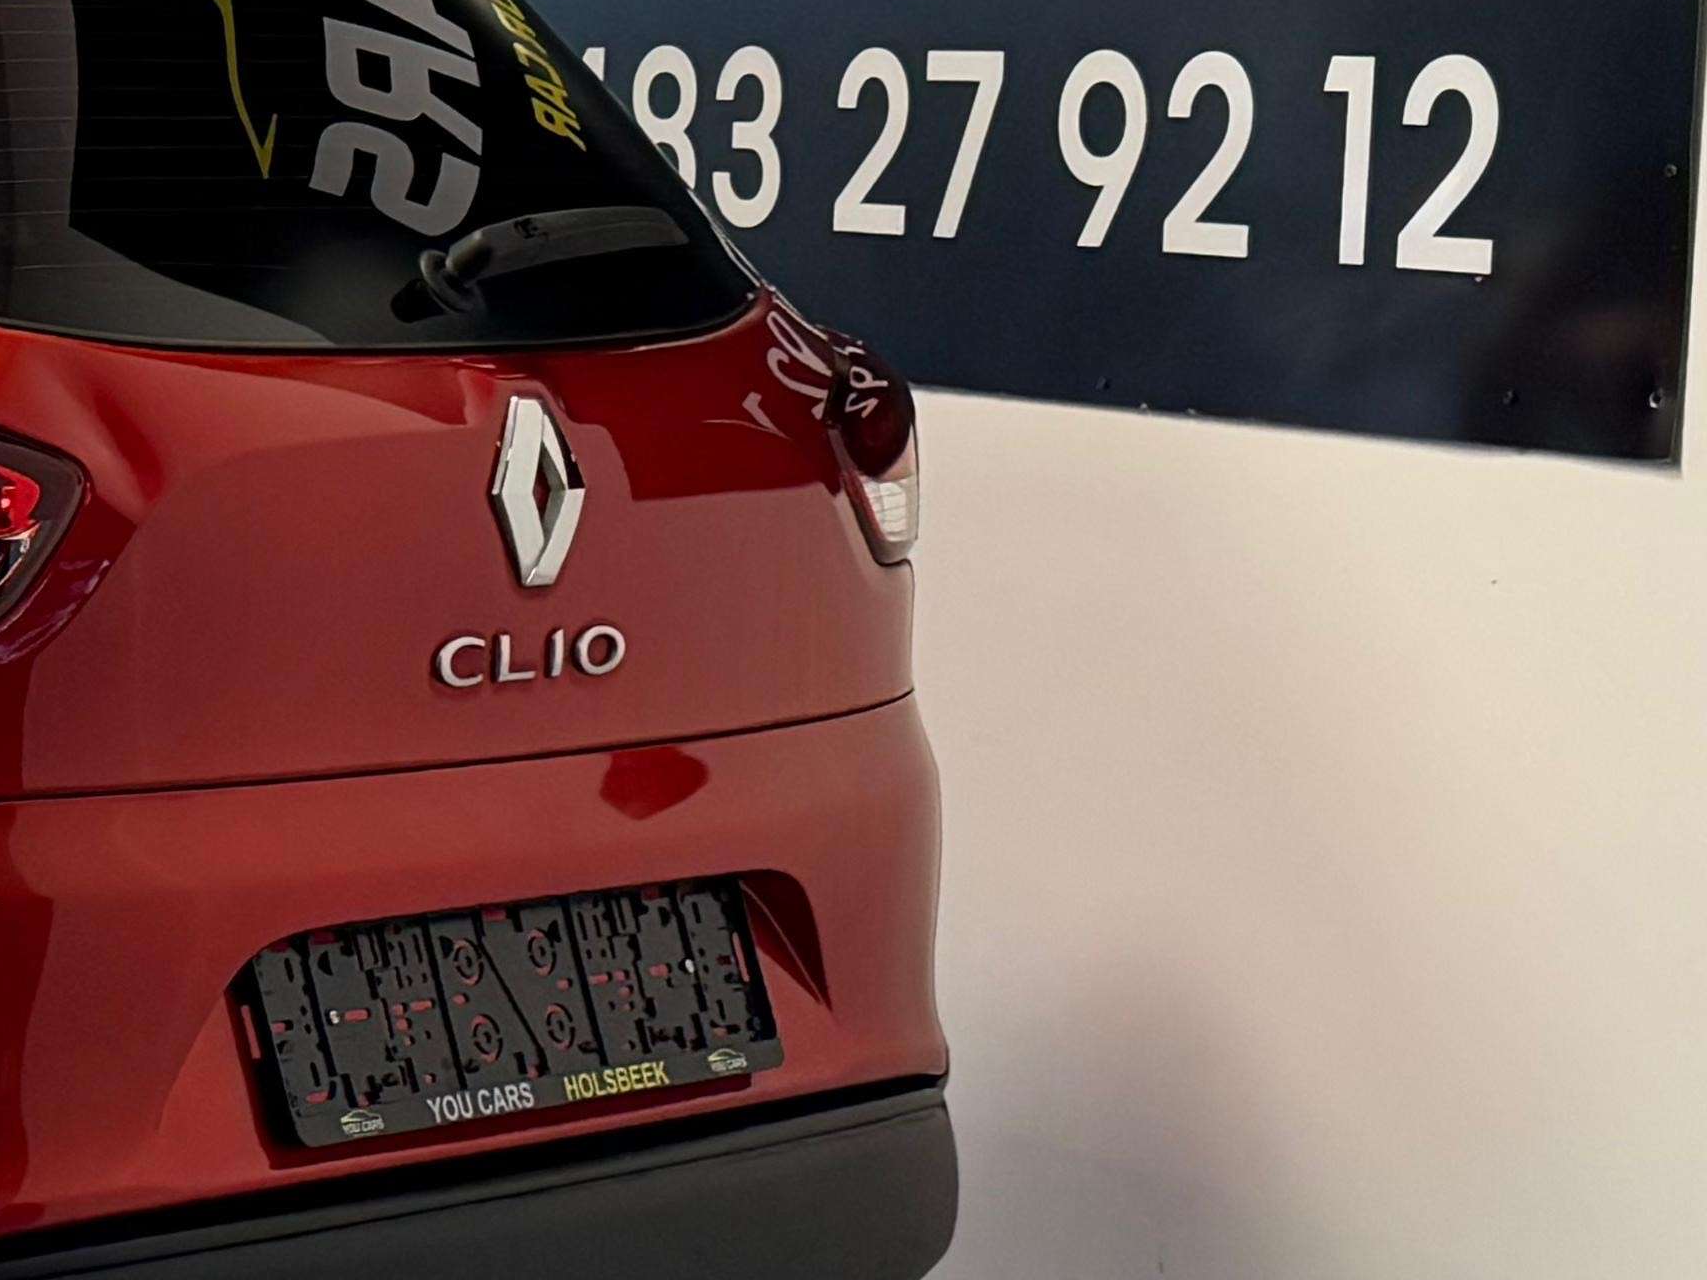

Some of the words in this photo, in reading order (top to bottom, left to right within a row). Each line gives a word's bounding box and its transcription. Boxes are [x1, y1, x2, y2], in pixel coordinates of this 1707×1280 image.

[582, 44, 783, 228] 83
[832, 46, 1005, 238] 27
[1057, 49, 1253, 258] 92
[1322, 54, 1499, 274] 12
[435, 624, 627, 688] CLIO
[427, 1090, 474, 1124] YOU
[477, 1081, 535, 1116] CARS
[563, 1060, 670, 1102] HOLSBEEK
